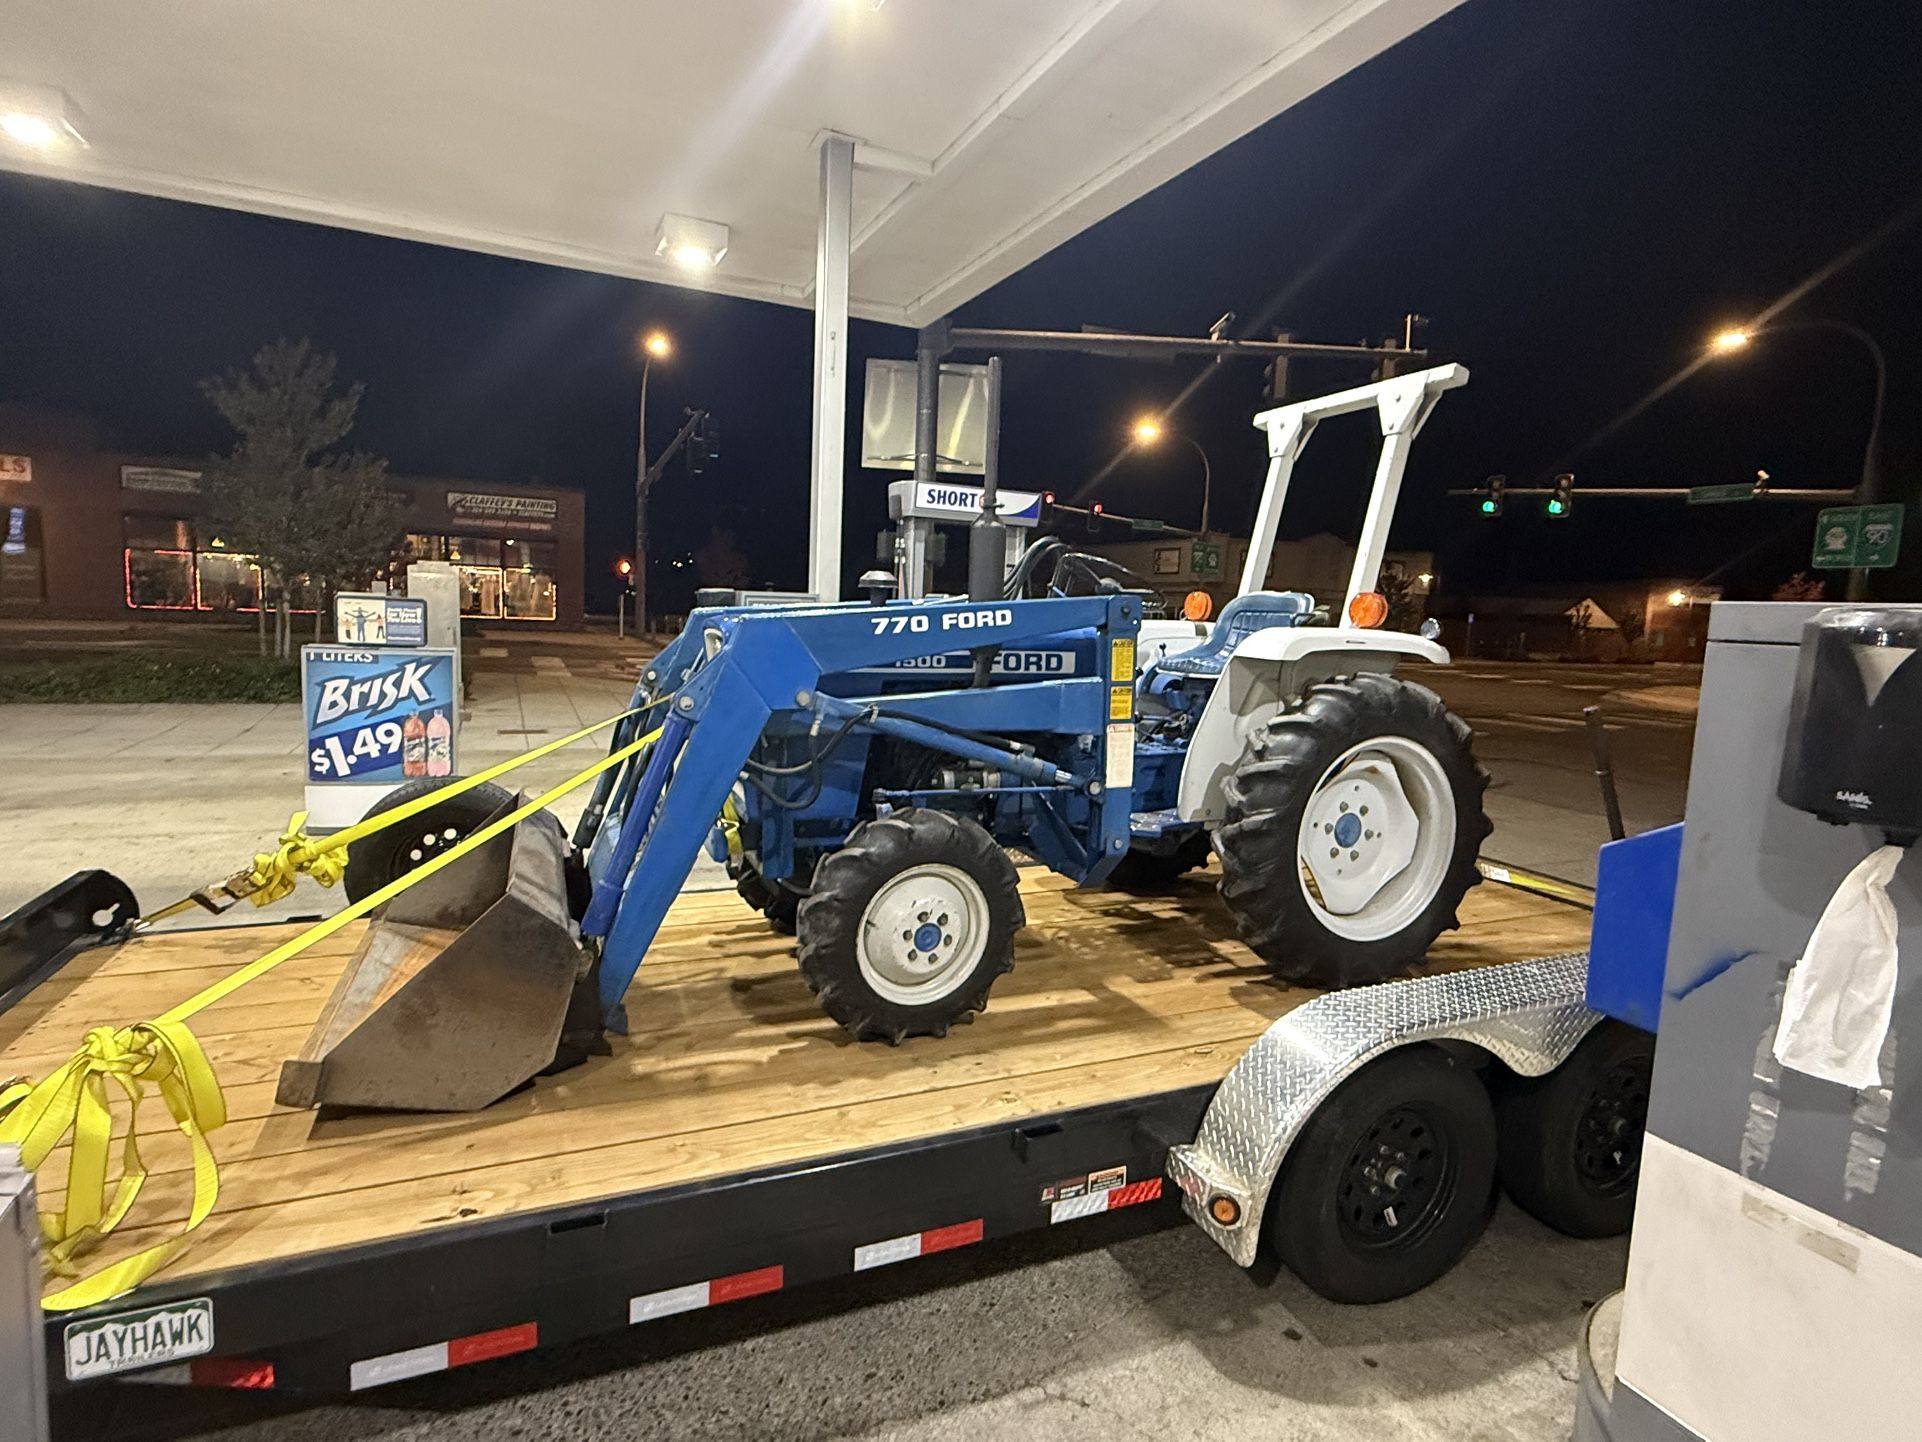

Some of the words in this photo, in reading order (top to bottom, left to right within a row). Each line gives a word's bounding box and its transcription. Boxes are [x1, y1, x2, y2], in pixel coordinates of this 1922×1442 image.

[515, 499, 556, 512] PAINTING
[926, 488, 978, 508] SHORT
[870, 615, 929, 635] 770
[942, 609, 1012, 630] FORD
[322, 652, 373, 663] LITERS
[311, 722, 403, 777] $1.49
[75, 1312, 204, 1366] JAYHAWK
